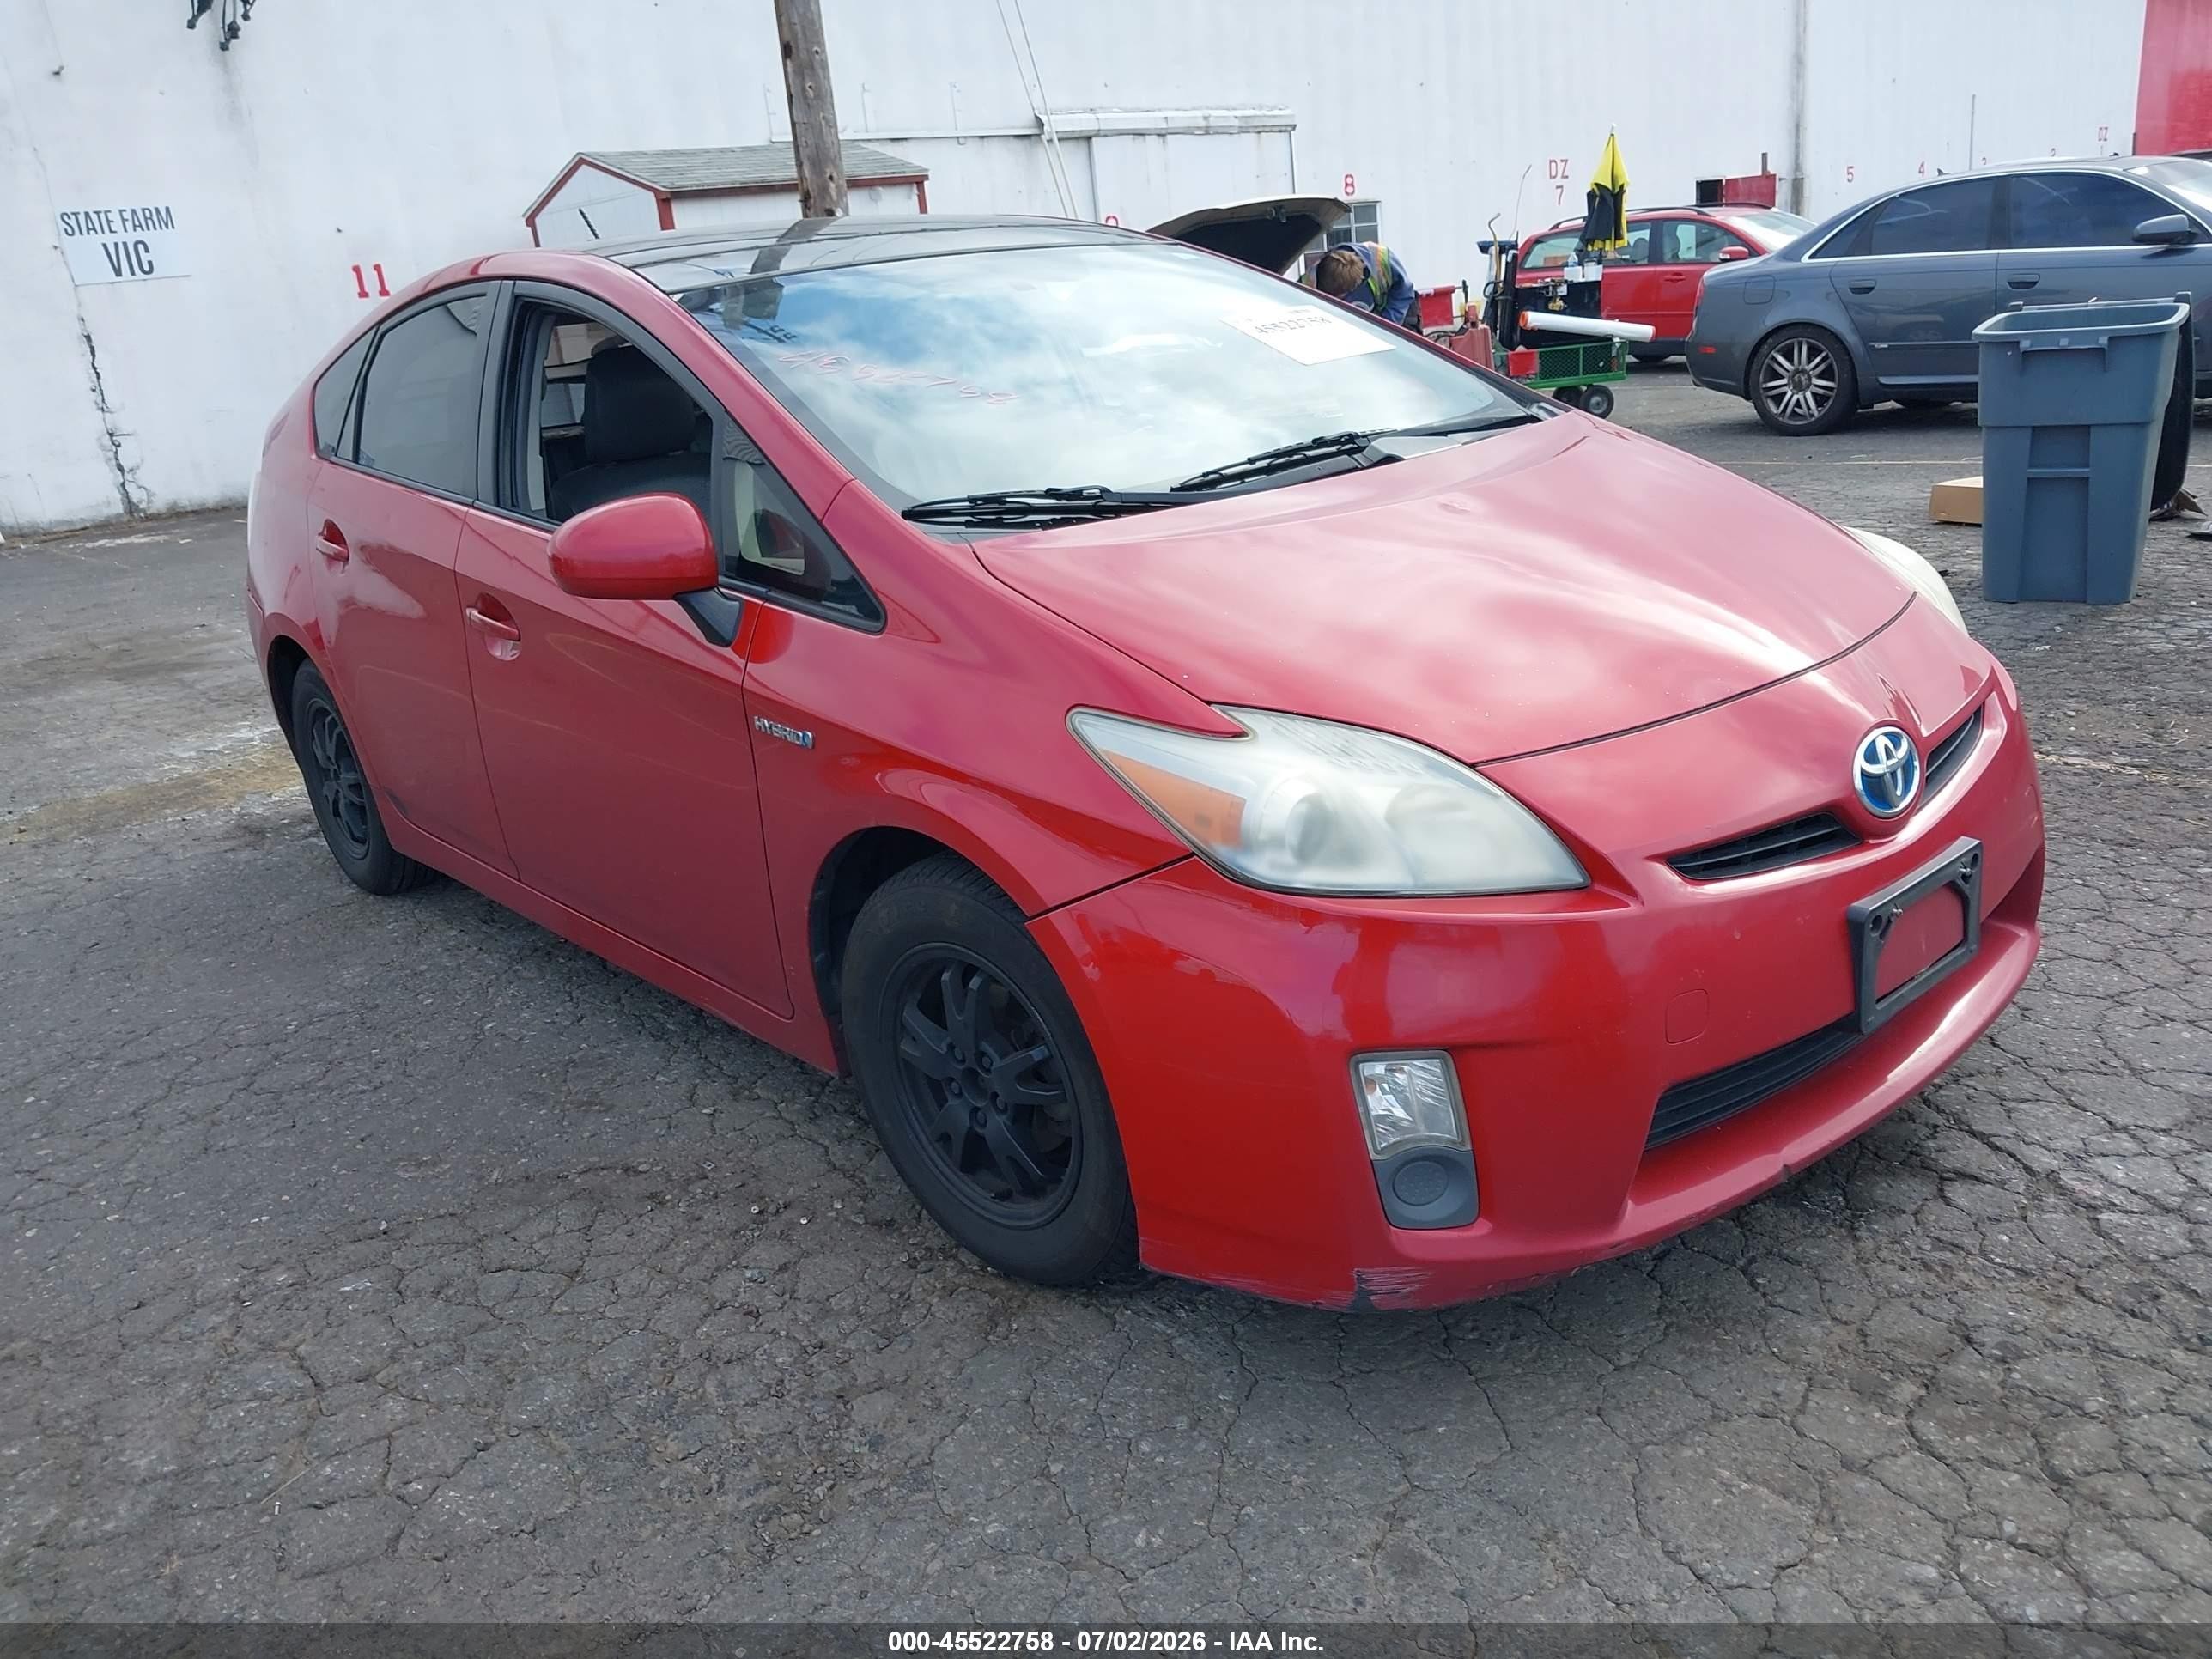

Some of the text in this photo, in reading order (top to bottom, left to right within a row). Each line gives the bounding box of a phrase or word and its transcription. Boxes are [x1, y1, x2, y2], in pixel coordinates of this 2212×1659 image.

[1549, 159, 1569, 179] DZ
[1846, 165, 1855, 183] 5
[1917, 161, 1925, 178] 4
[1344, 173, 1355, 197] 8
[1555, 185, 1565, 206] 7
[59, 205, 175, 237] STATE FARM
[100, 239, 155, 277] VIC
[352, 263, 391, 299] 11
[754, 715, 804, 746] HYBRID
